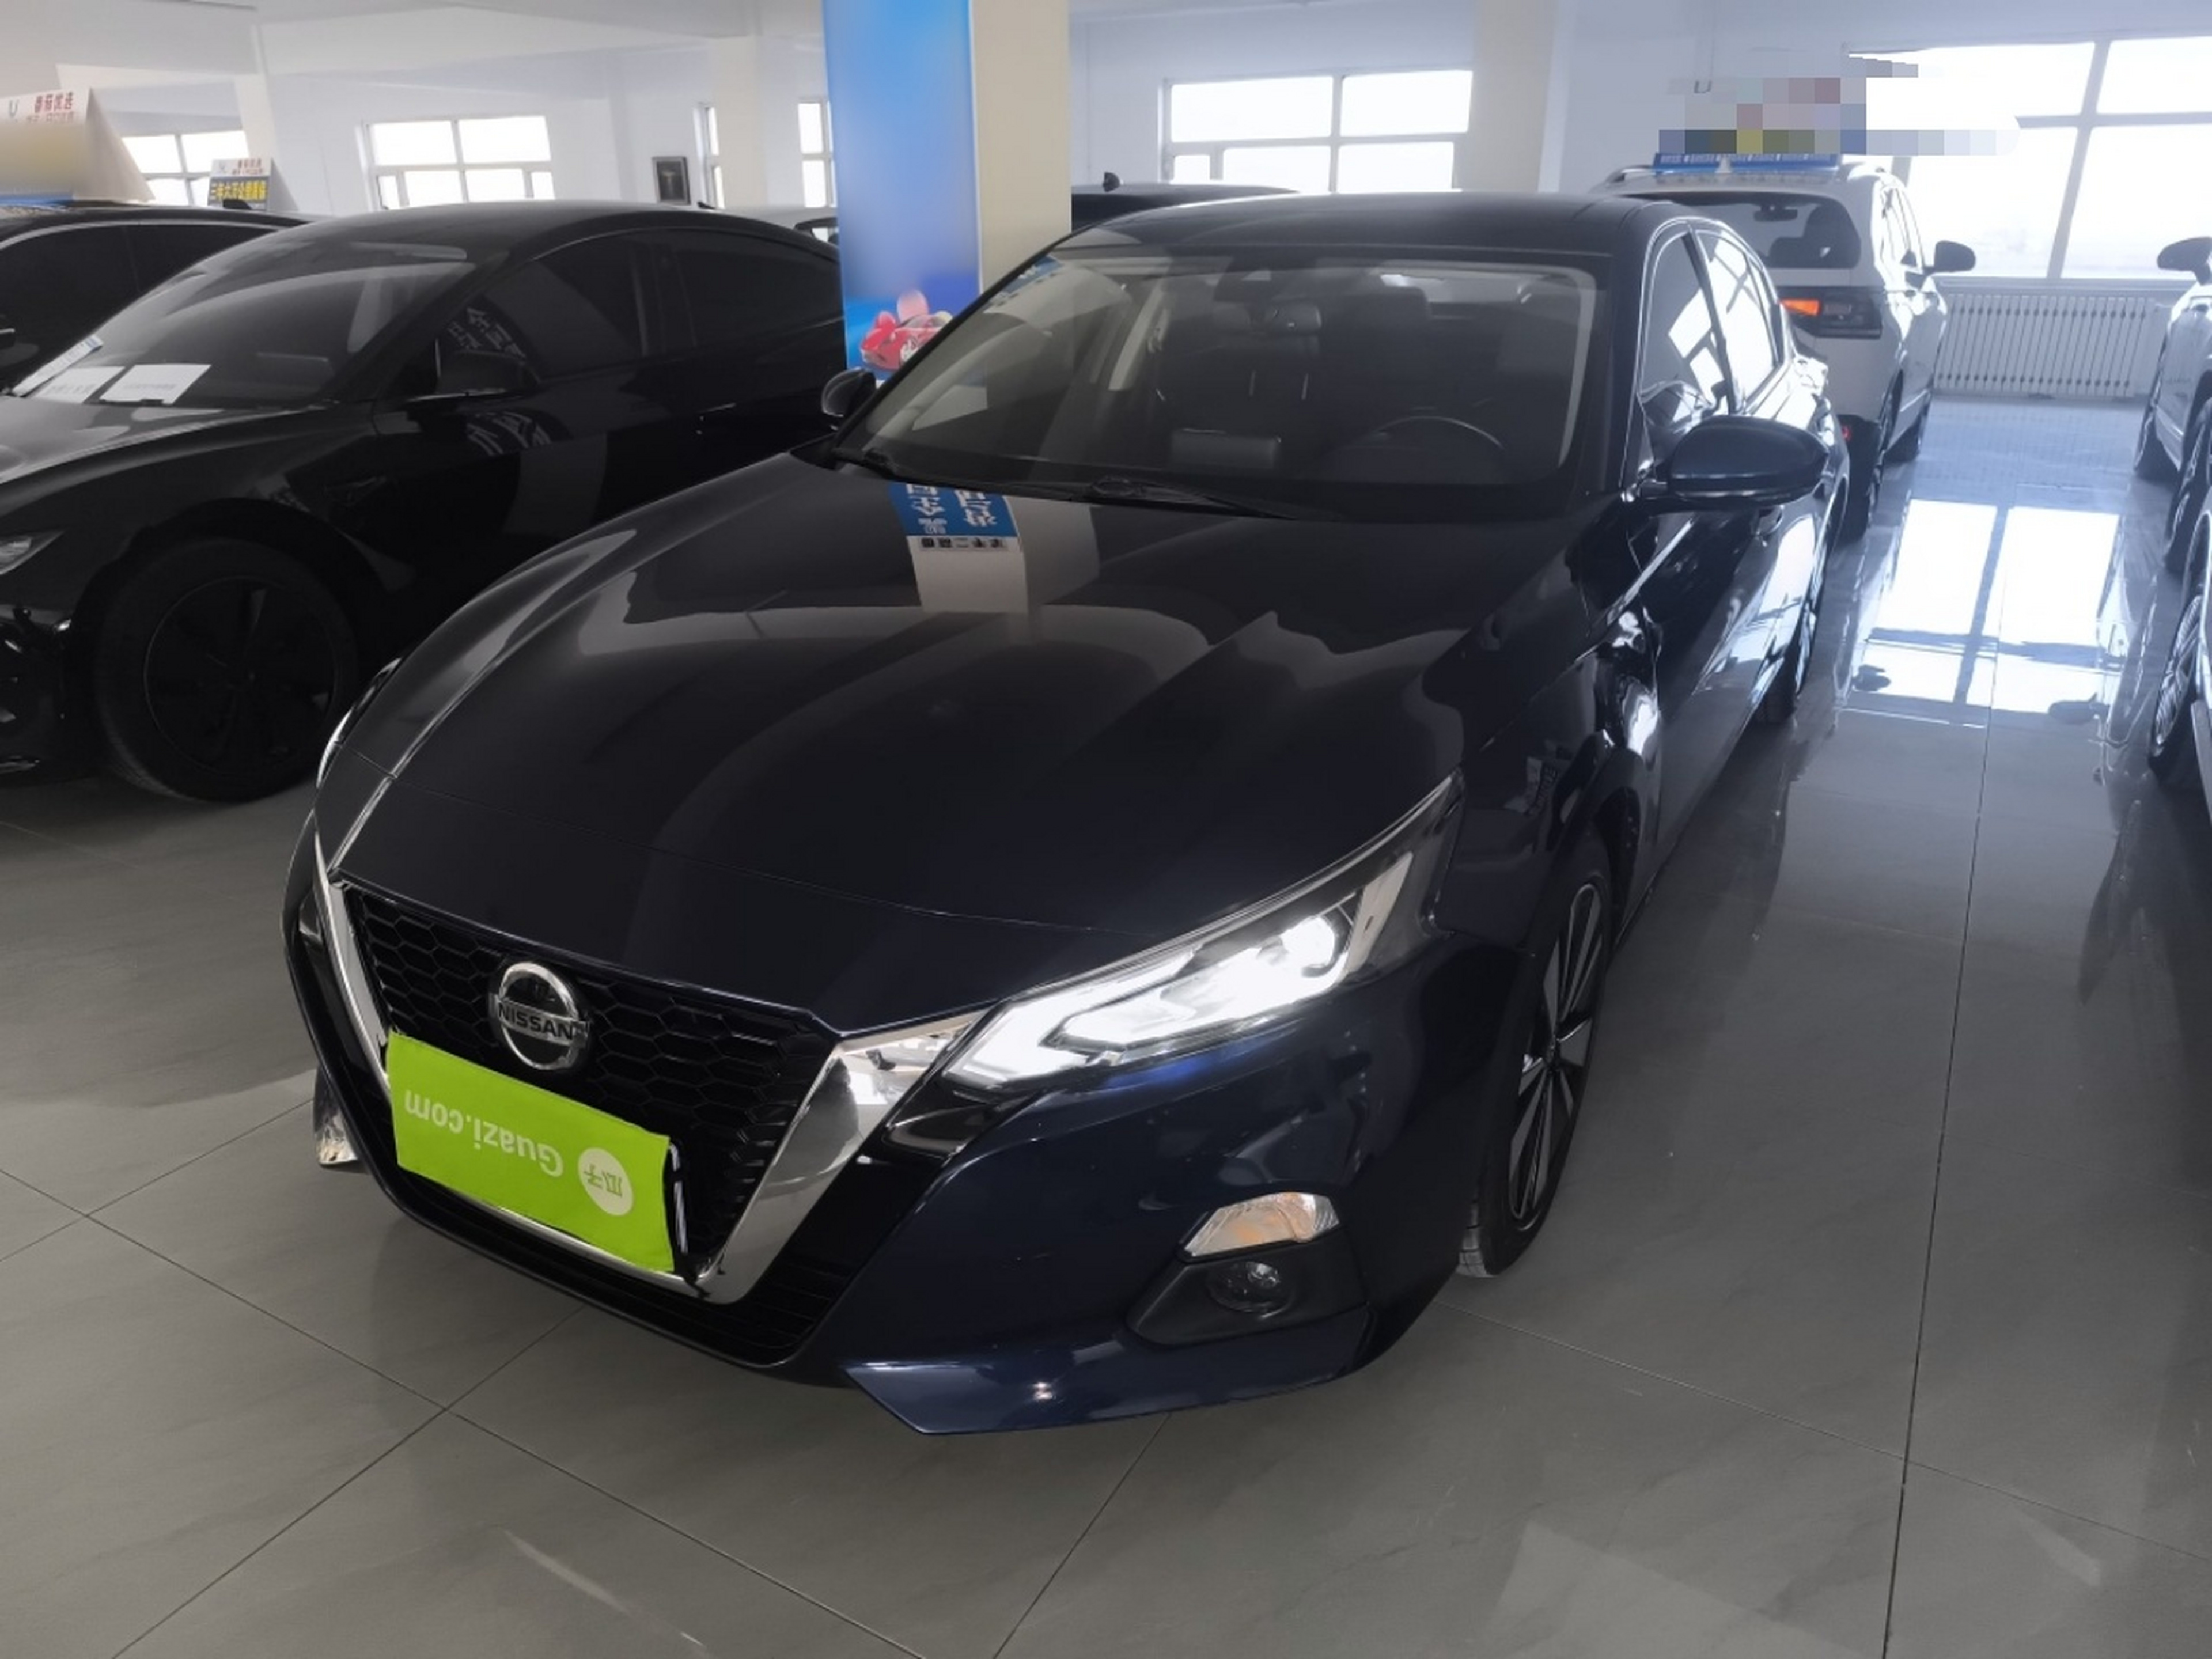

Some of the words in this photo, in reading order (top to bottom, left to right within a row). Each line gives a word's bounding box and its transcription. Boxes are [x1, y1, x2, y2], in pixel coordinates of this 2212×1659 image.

[499, 1002, 573, 1040] NISSAN
[404, 1089, 564, 1177] Guazi.com
[583, 1163, 623, 1198] 瓜子
